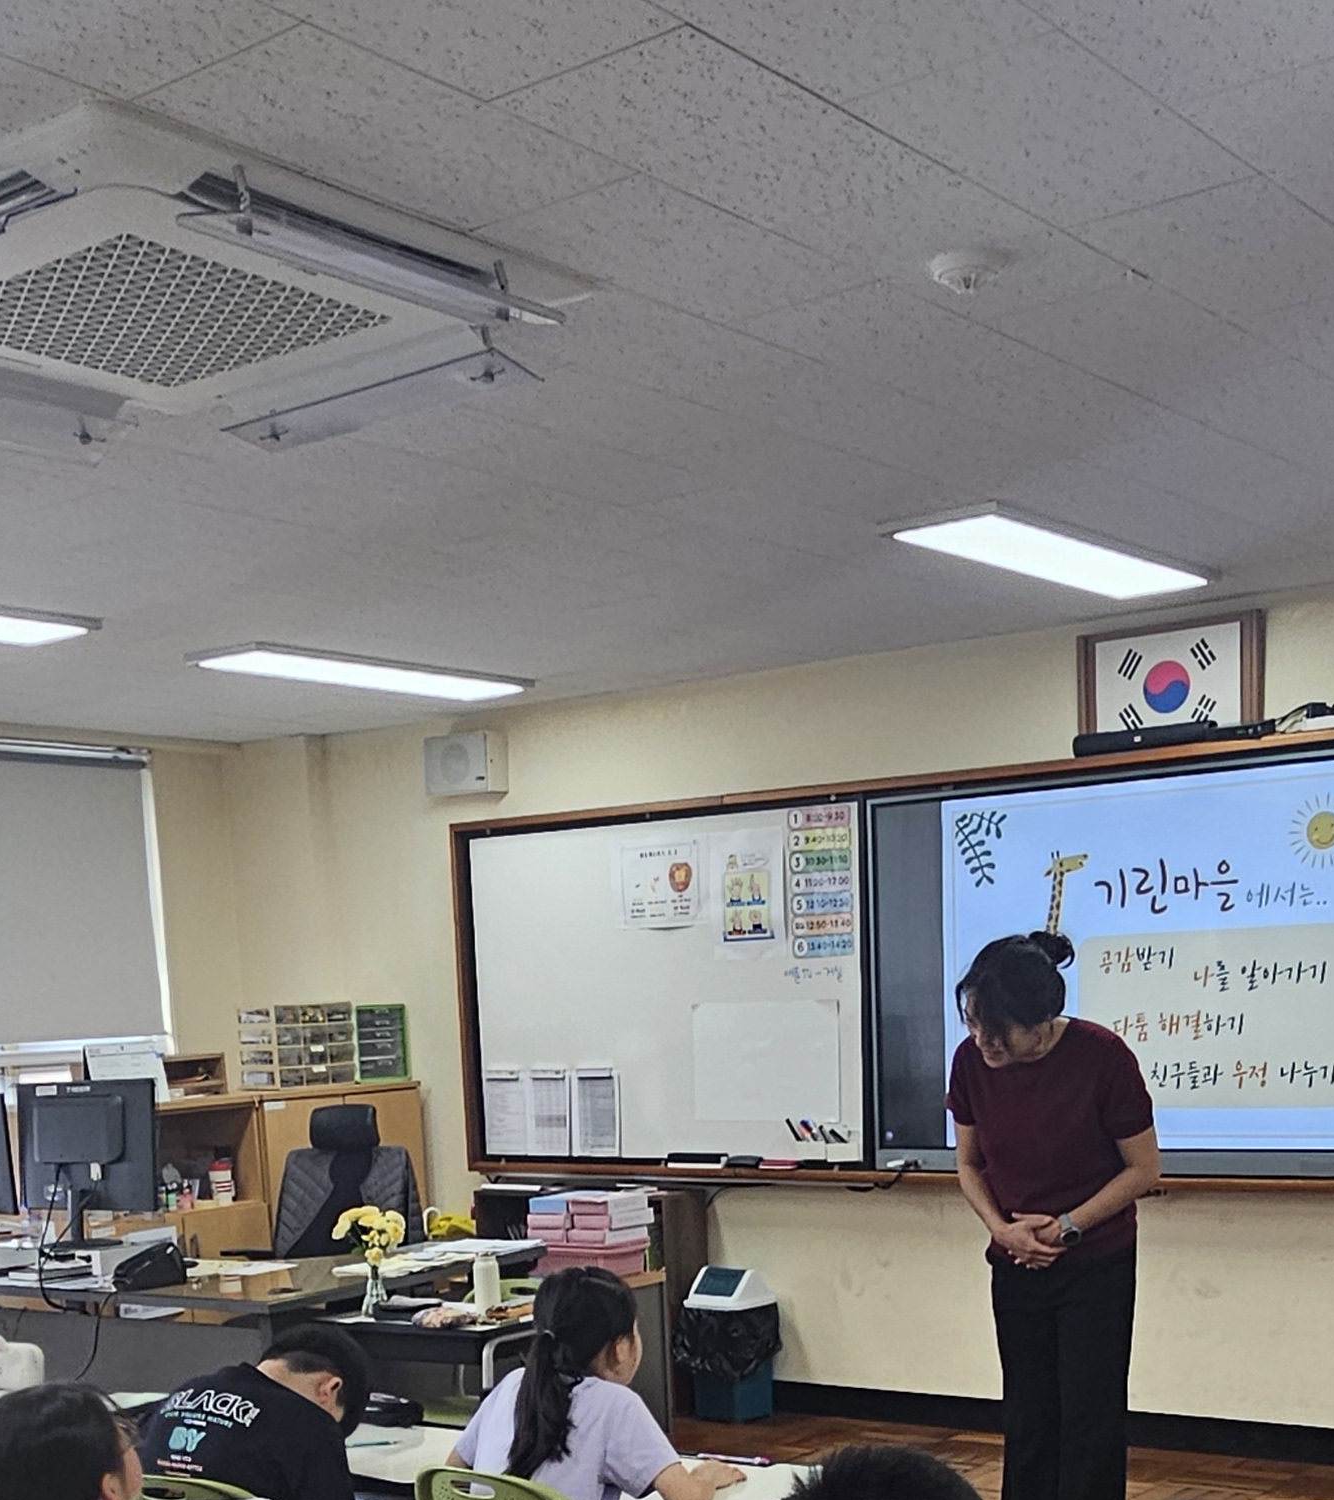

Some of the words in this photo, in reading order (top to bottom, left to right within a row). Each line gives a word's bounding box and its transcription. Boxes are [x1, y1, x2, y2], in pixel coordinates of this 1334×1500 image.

[1094, 857, 1239, 915] 기린마을
[1099, 945, 1175, 974] 공감받기
[1193, 960, 1230, 993] 나를
[1240, 959, 1328, 992] 알아가기
[1113, 1012, 1149, 1043] 다툼
[1158, 1009, 1245, 1041] 해결하기
[1150, 1059, 1224, 1091] 친구들과
[1232, 1059, 1269, 1090] 우정
